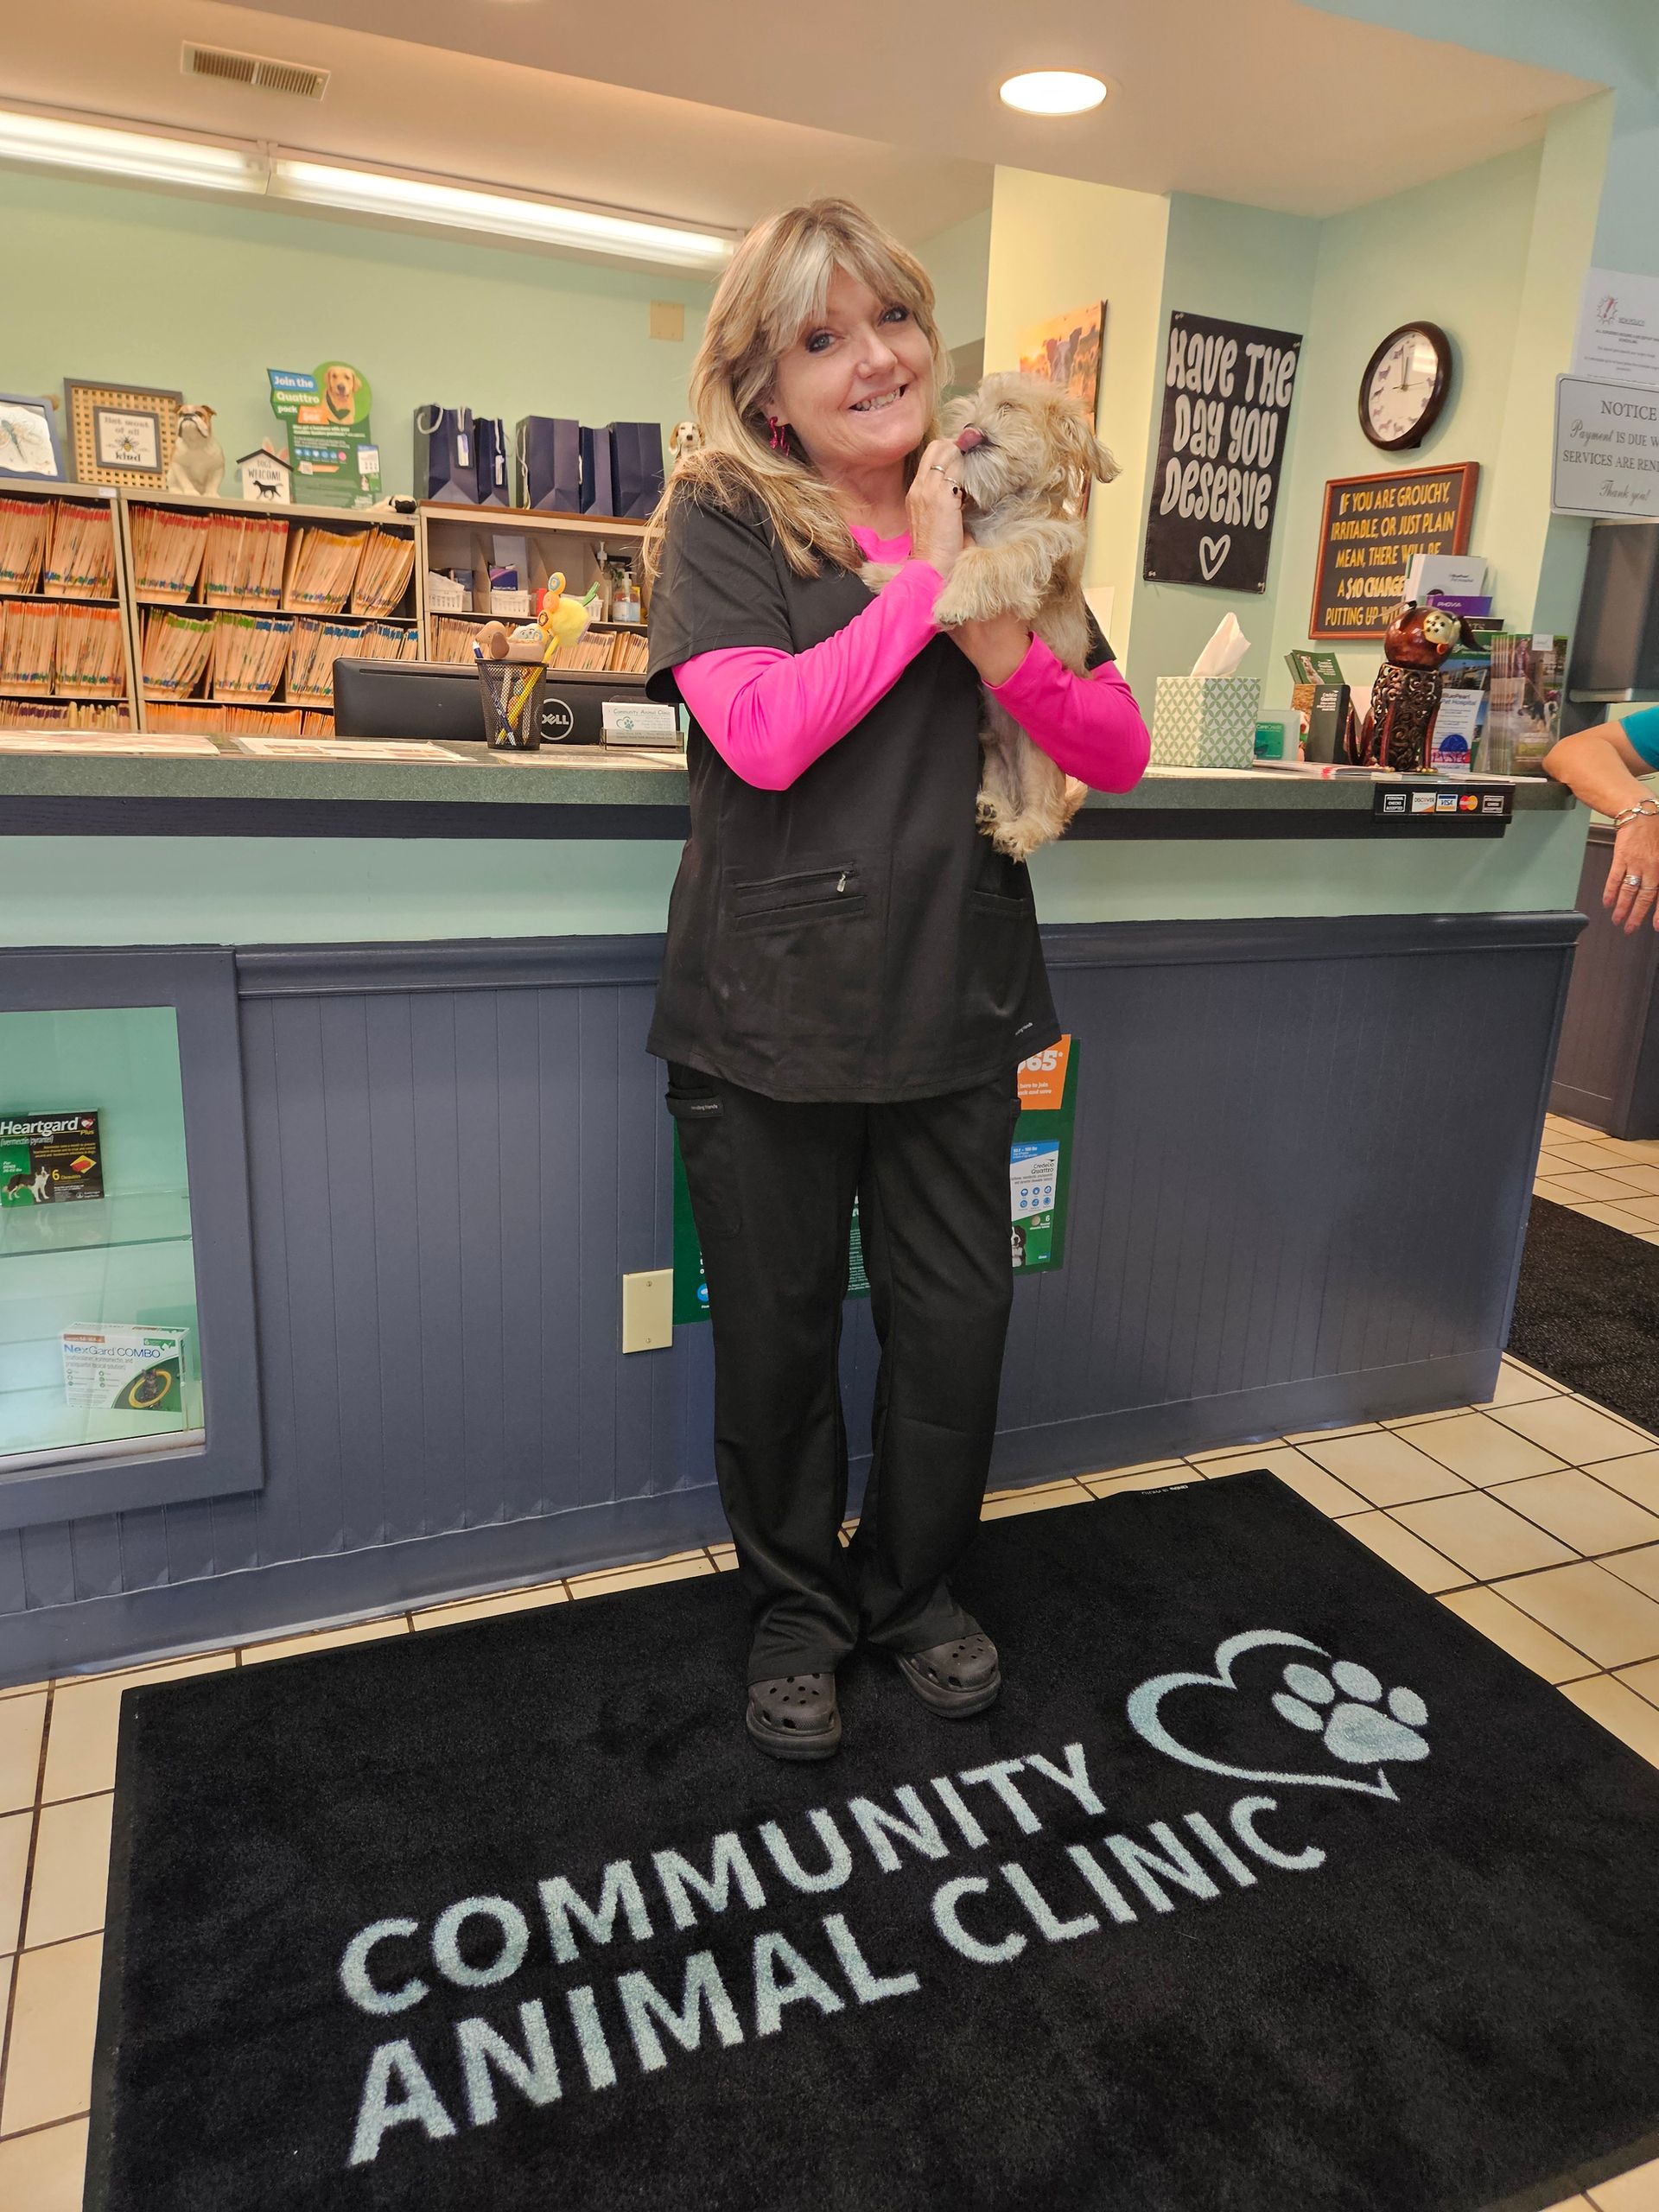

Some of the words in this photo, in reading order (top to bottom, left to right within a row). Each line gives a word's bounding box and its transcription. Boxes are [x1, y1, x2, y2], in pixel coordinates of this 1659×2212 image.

[275, 376, 296, 386] Join
[296, 378, 314, 388] the
[276, 391, 320, 404] Quattro
[277, 405, 297, 414] pack
[1601, 400, 1657, 421] NOTICE
[1570, 419, 1613, 447] Payment
[1616, 431, 1625, 443] IS
[1628, 433, 1647, 447] DUE
[116, 452, 141, 461] kind
[1563, 449, 1613, 467] SERVICES
[1615, 456, 1635, 469] ARE
[248, 469, 281, 480] WELCOME
[1339, 492, 1351, 516] IF
[1352, 491, 1374, 512] YOU
[1374, 488, 1396, 510] ARE
[1397, 481, 1451, 507] GROUCHY,
[1599, 480, 1630, 499] Thank
[1331, 518, 1379, 541] IRRITABLE,
[1381, 516, 1396, 537] OR
[1398, 513, 1422, 536] JUST
[1421, 511, 1455, 533] PLAIN
[1335, 548, 1365, 568] MEAN,
[1369, 544, 1399, 566] THERE
[1337, 579, 1344, 598] A
[1345, 576, 1363, 600] $10
[1363, 575, 1406, 598] CHARGE
[1325, 607, 1363, 626] PUTTING
[1365, 606, 1379, 626] UP
[0, 1116, 79, 1137] Heartgard
[52, 1169, 60, 1180] 6
[64, 1344, 115, 1356] NexGard
[117, 1348, 161, 1358] COMBO
[340, 1743, 1105, 2014] COMMUNITY
[350, 1913, 919, 2164] ANIMAL
[931, 1796, 1326, 1964] CLINIC
